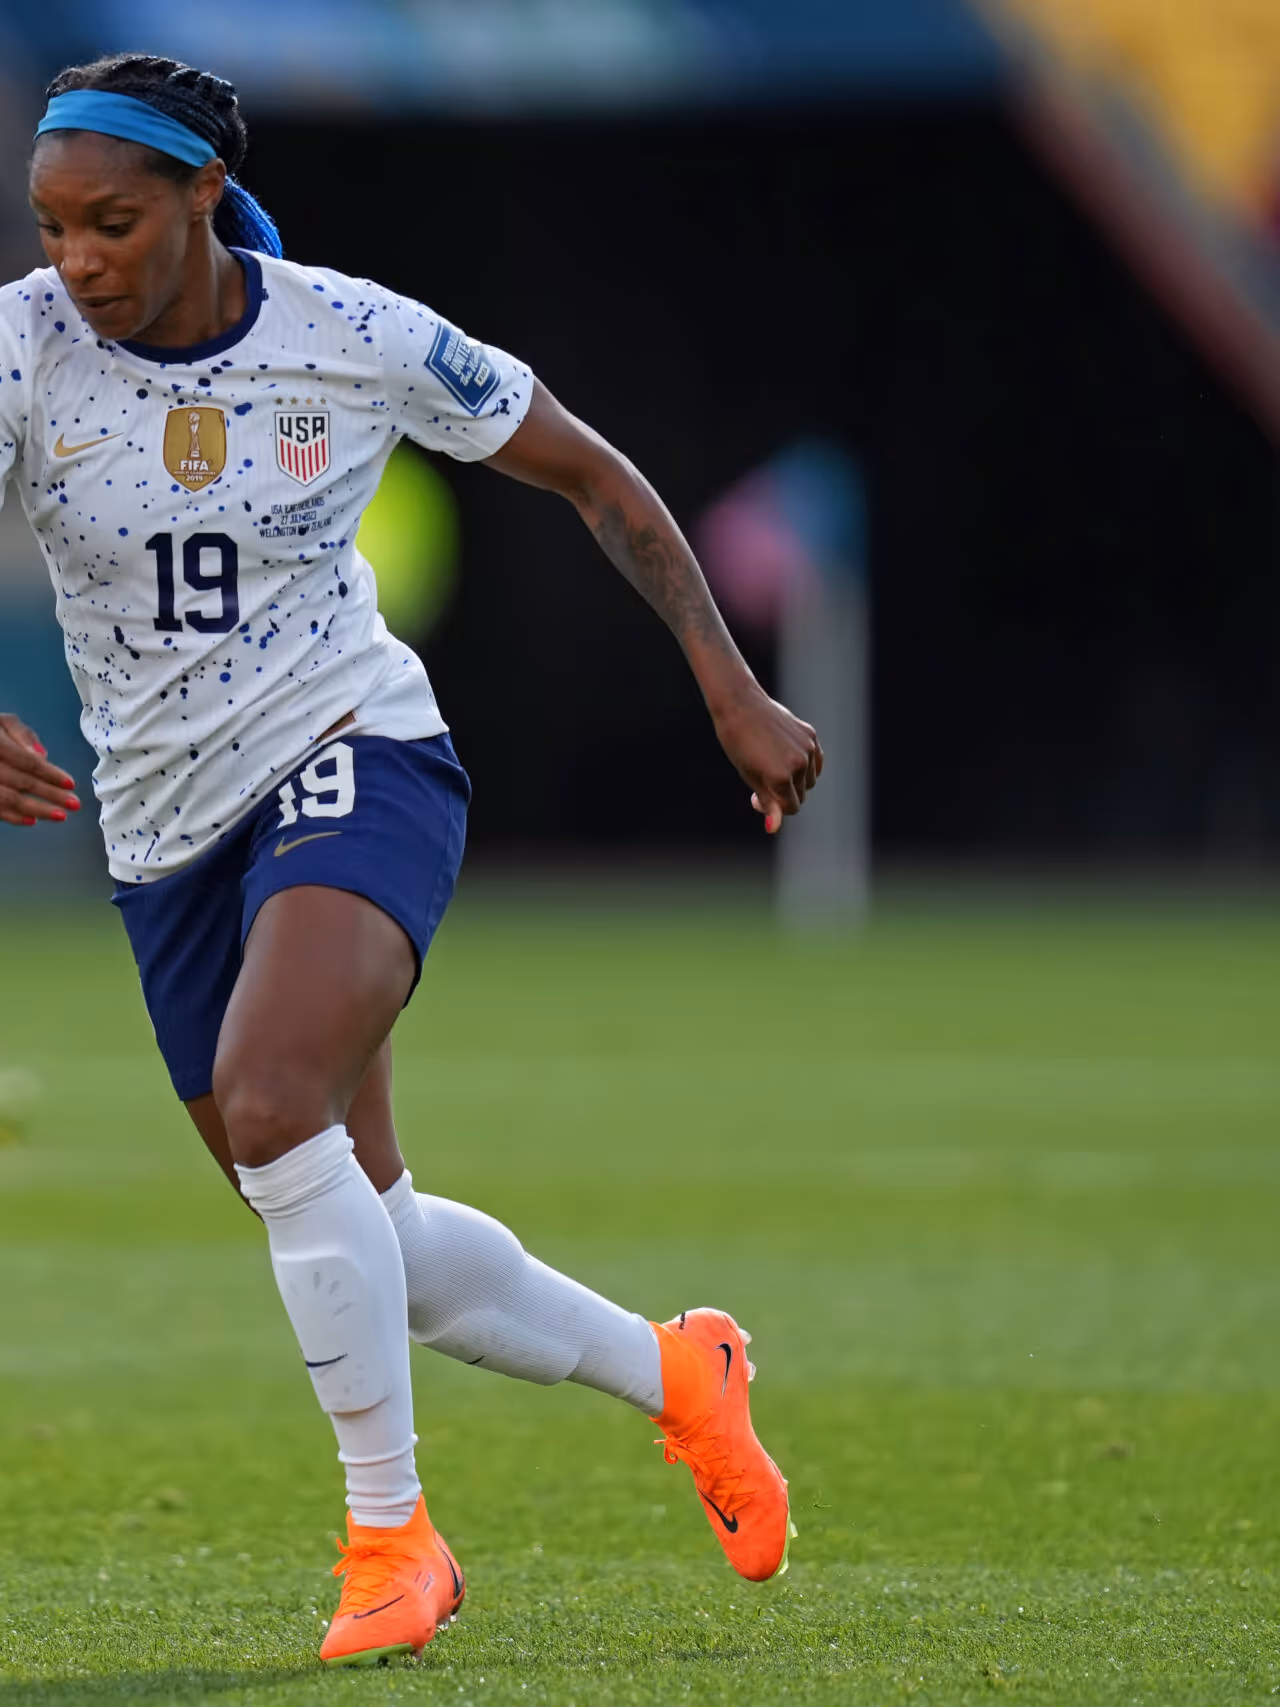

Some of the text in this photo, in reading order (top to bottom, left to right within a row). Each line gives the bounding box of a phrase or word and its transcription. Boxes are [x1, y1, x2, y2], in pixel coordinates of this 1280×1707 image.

[280, 416, 325, 443] USA
[180, 460, 209, 470] FIFA
[271, 504, 282, 515] USA
[145, 532, 239, 634] 19
[277, 741, 356, 828] 19
